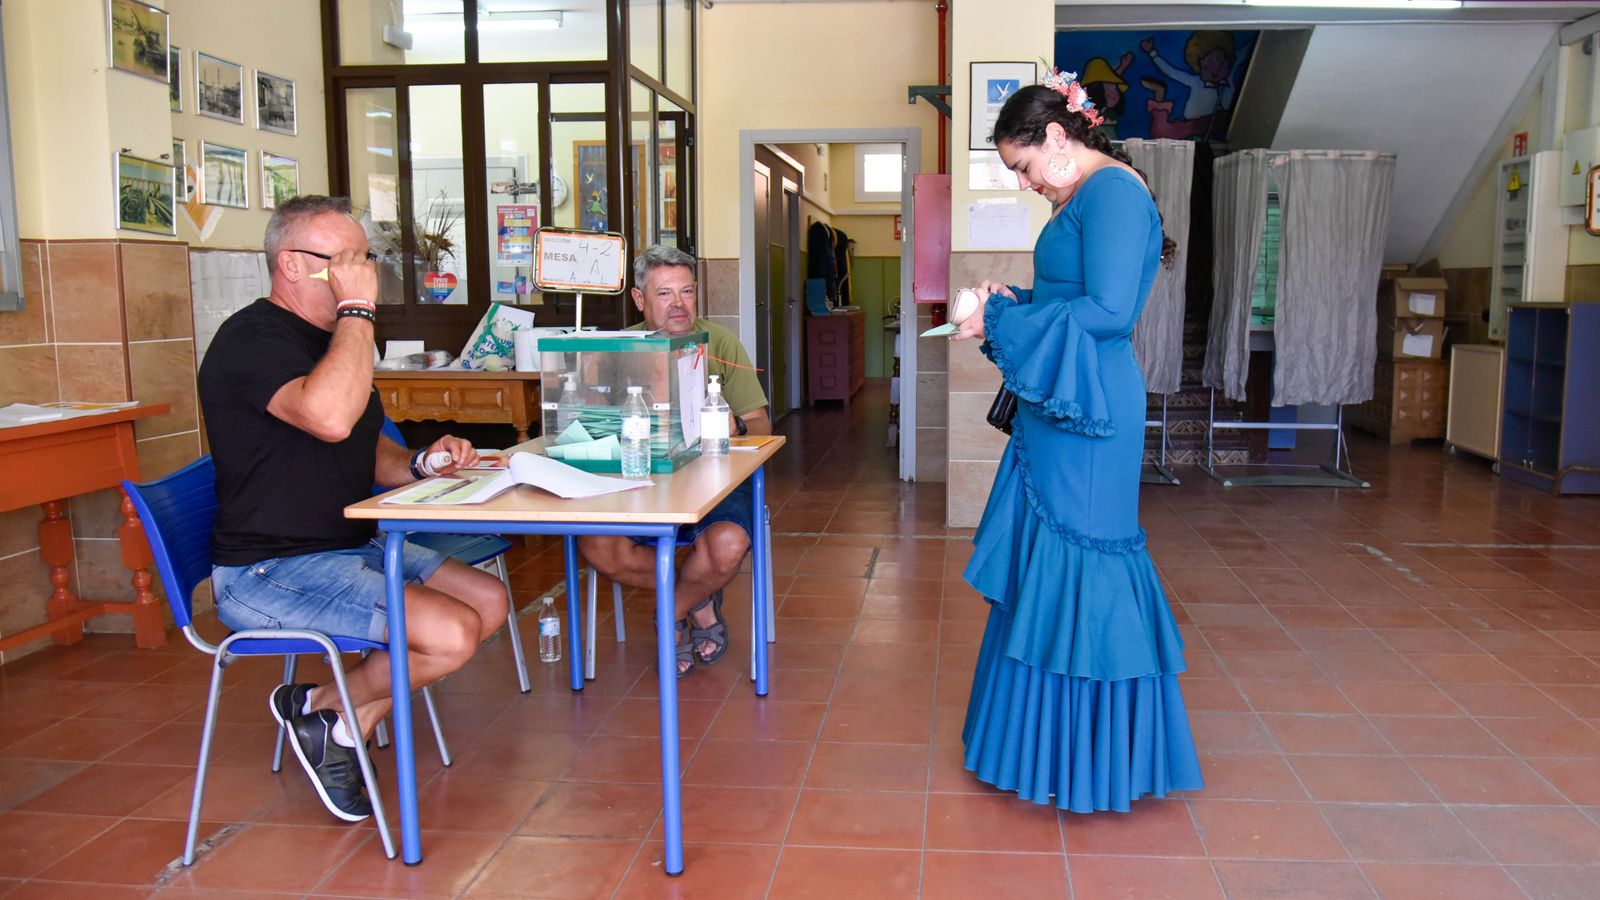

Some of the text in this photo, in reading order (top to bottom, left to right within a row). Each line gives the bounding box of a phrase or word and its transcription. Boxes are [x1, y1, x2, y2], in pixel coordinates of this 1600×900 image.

[544, 252, 577, 262] MESA
[590, 258, 600, 275] A
[569, 271, 577, 283] A
